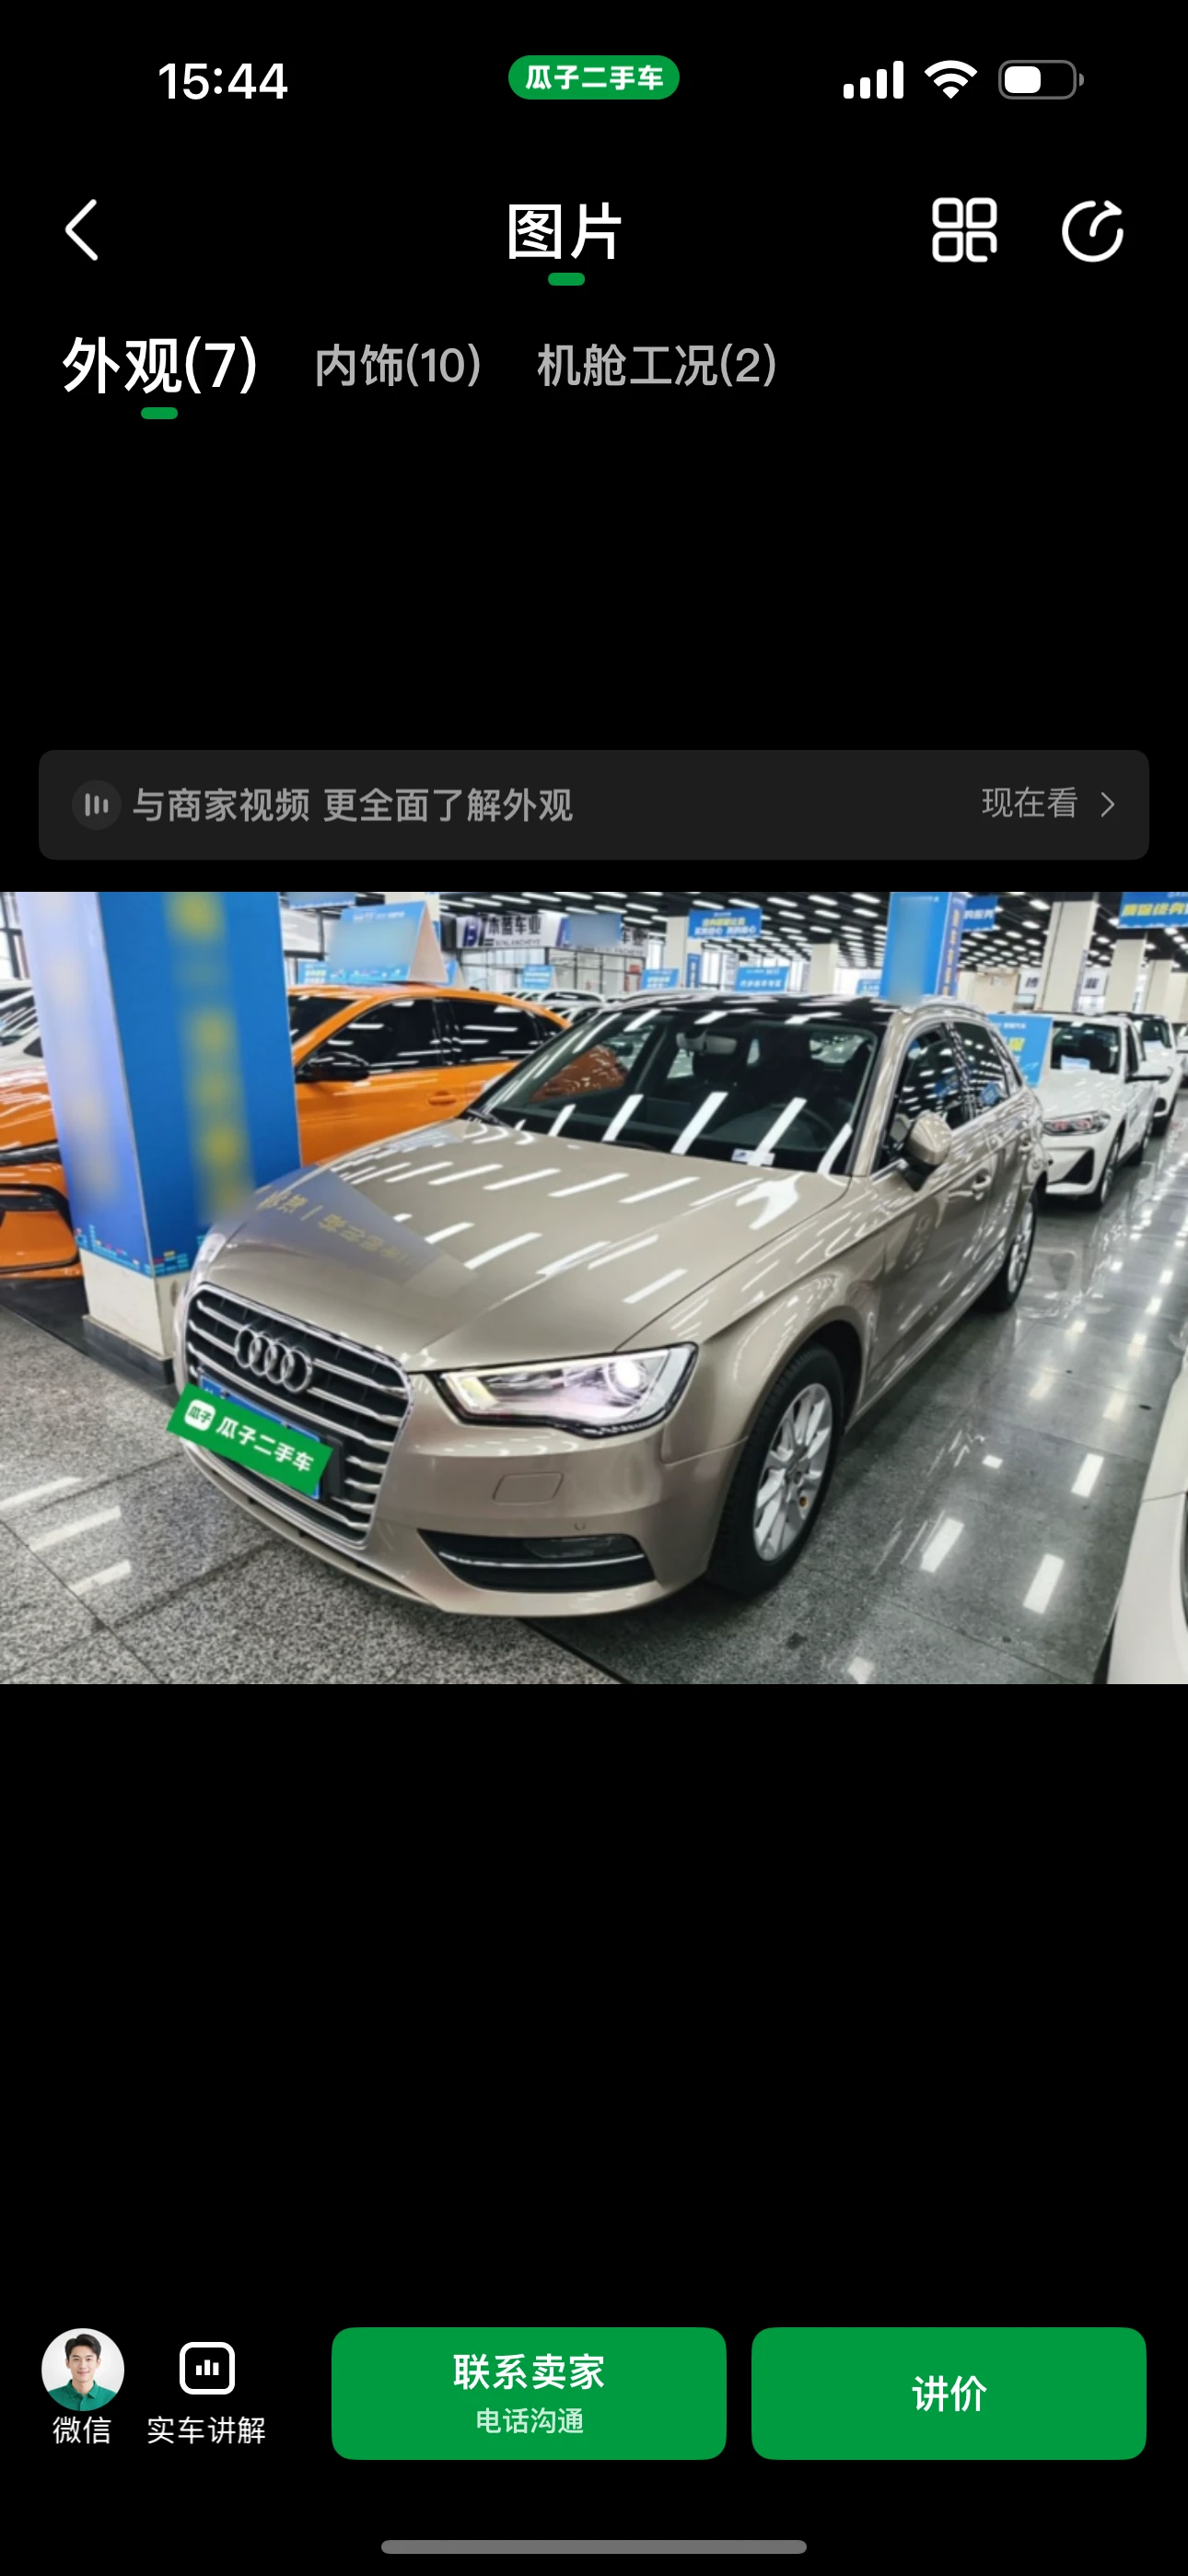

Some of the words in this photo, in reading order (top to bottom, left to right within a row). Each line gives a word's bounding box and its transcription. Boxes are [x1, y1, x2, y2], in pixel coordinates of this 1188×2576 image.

[159, 64, 287, 100] 15:44
[526, 65, 663, 89] 瓜子二手车
[509, 202, 621, 259] 图片
[63, 336, 255, 393] 外观(7)
[317, 344, 480, 386] 内饰(10)
[538, 344, 775, 386] 机舱工况(2)
[134, 788, 309, 822] 与商家视频
[324, 788, 573, 822] 更全面了解外观
[983, 787, 1077, 818] 现在看
[454, 2353, 604, 2389] 联系卖家
[913, 2376, 986, 2411] 讲价
[53, 2416, 111, 2444] 微信
[148, 2416, 265, 2444] 实车讲解
[477, 2407, 583, 2433] 电话沟通
